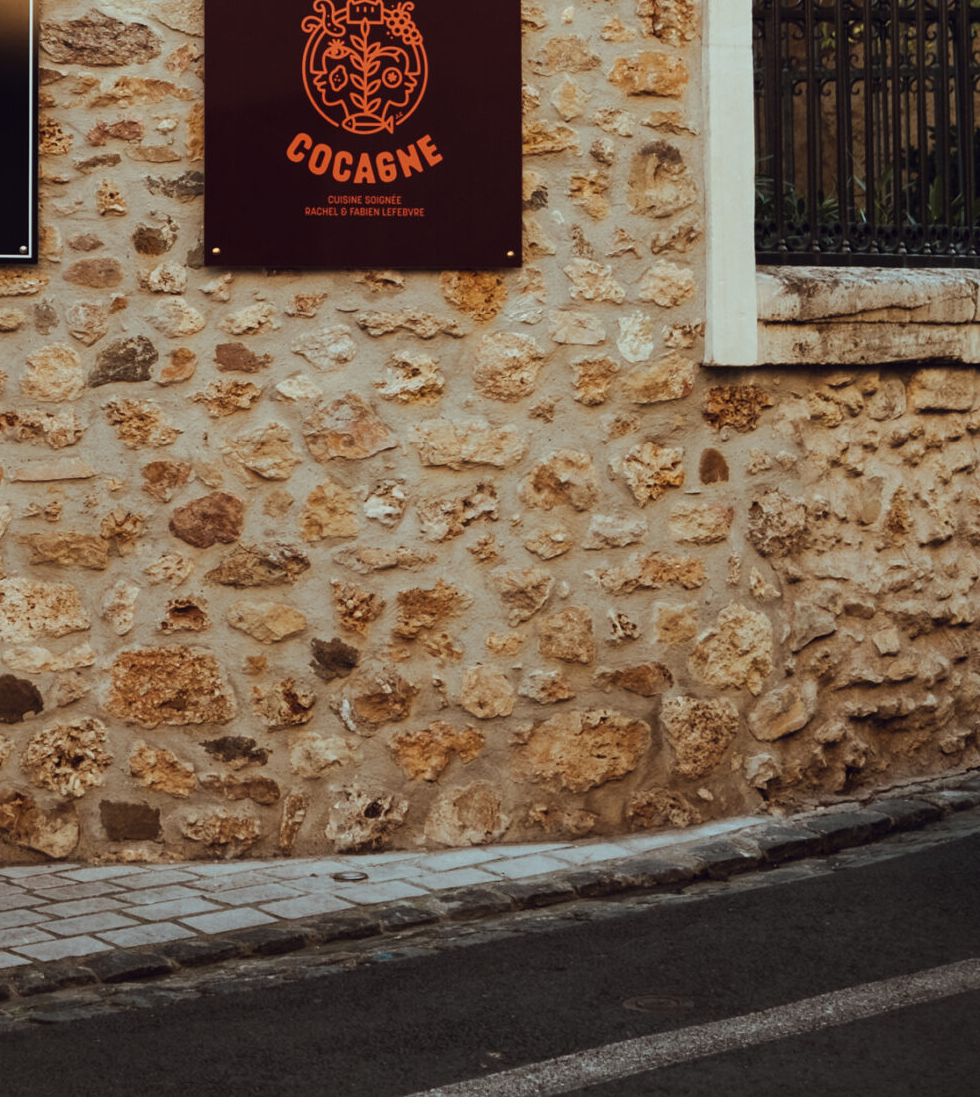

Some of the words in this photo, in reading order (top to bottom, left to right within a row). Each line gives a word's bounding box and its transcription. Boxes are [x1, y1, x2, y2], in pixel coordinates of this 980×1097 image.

[286, 132, 444, 184] COCAGNE
[327, 195, 363, 205] CUISINE
[365, 193, 402, 205] SOIGNÉE
[304, 206, 339, 217] RACHEL
[340, 206, 348, 217] &
[349, 206, 380, 217] FABIEN
[381, 207, 425, 217] LEFEBVRE
